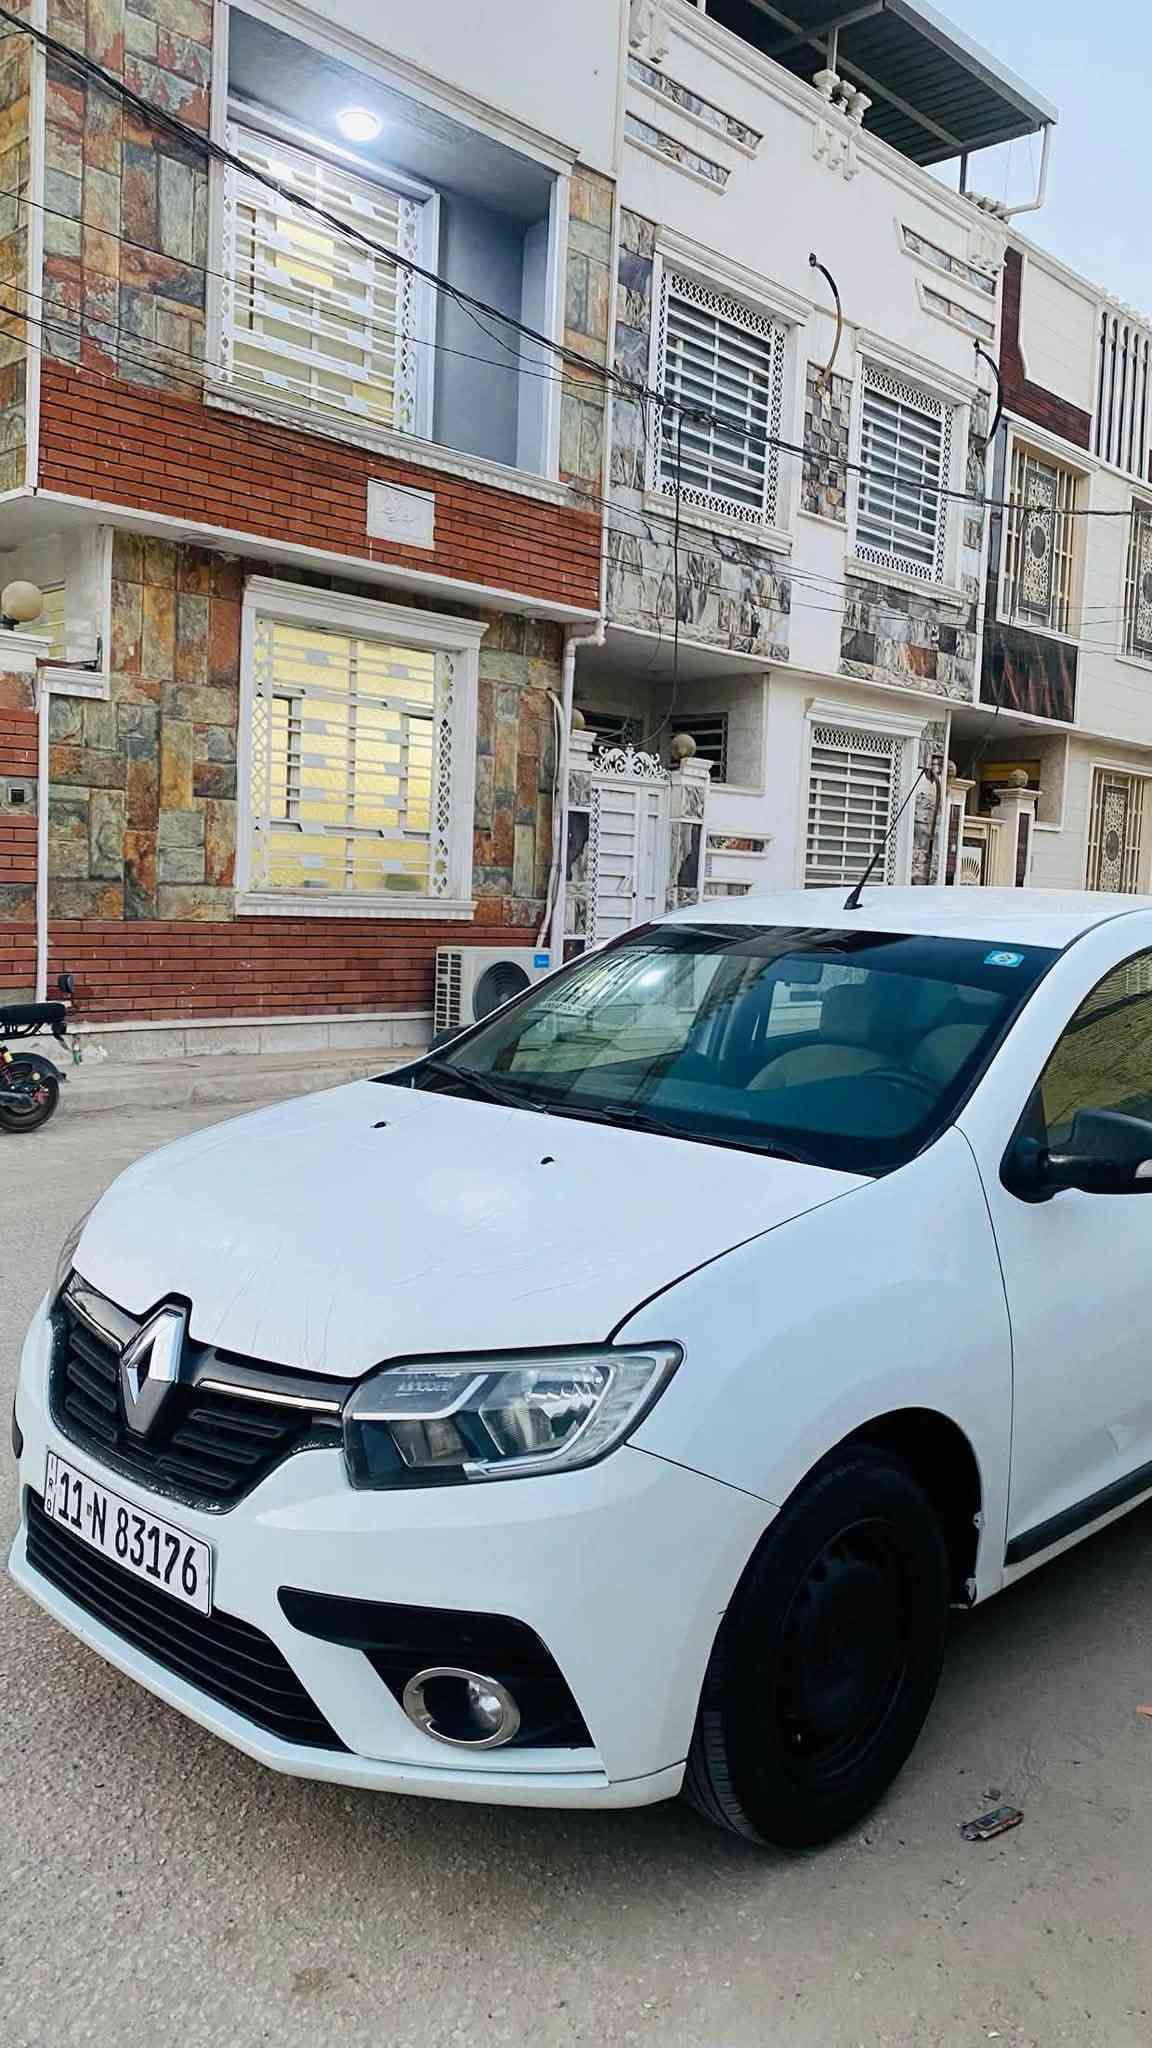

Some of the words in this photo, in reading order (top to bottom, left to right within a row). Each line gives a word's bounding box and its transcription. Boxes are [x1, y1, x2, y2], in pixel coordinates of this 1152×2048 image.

[58, 1471, 83, 1530] 11
[91, 1491, 107, 1546] N
[114, 1507, 198, 1596] 83176
